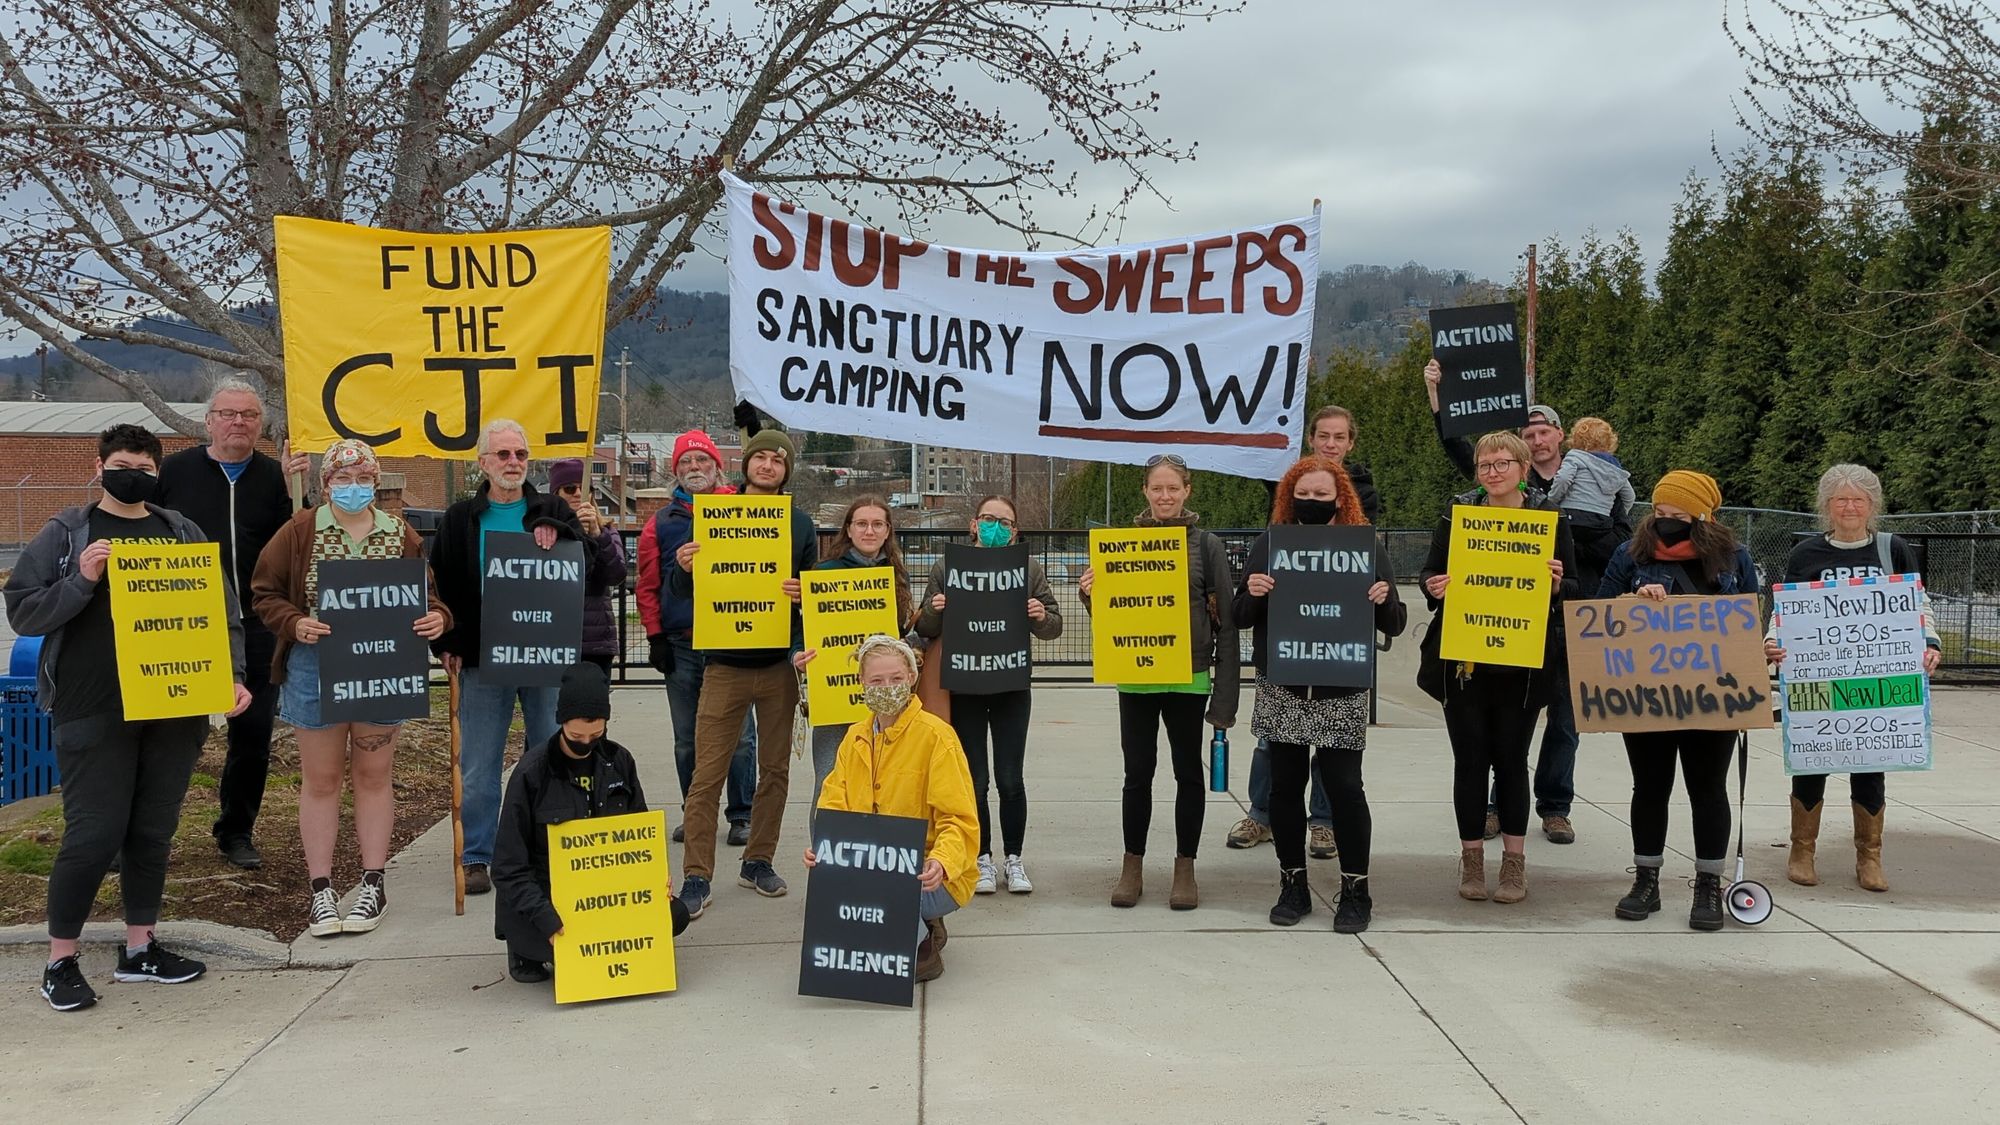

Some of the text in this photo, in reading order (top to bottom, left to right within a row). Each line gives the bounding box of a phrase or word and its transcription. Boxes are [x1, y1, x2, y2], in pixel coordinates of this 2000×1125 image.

[752, 192, 1306, 316] STOP THE SWEEPS
[381, 243, 536, 290] FUND
[422, 305, 506, 352] THE
[756, 288, 1024, 375] SANCTUARY
[1436, 324, 1513, 347] ACTION
[1462, 368, 1496, 380] OVER
[779, 356, 965, 421] CAMPING
[1039, 340, 1302, 426] NOW!
[322, 353, 594, 451] CJI
[1450, 394, 1522, 417] SILENCE
[703, 507, 783, 519] DON'T MAKE
[709, 528, 779, 538] DECISIONS
[1463, 518, 1548, 535] DON'T MAKE
[1099, 540, 1179, 553] DON'T MAKE
[1468, 539, 1541, 555] DECISIONS
[118, 556, 211, 570] DON'T MAKE
[487, 558, 578, 581] ACTION
[711, 562, 776, 574] ABOUT US
[1106, 560, 1176, 573] DECISIONS
[1273, 550, 1369, 573] ACTION
[127, 578, 207, 592] DECISIONS
[811, 578, 889, 594] DON'T MAKE
[947, 568, 1024, 591] ACTION
[1465, 575, 1535, 590] ABOUT US
[321, 585, 419, 610] ACTION
[818, 598, 886, 613] DECISIONS
[1110, 595, 1175, 608] ABOUT US
[1781, 587, 1917, 619] FDR's New Deal
[713, 601, 775, 613] WITHOUT
[1300, 604, 1340, 617] OVER
[134, 616, 208, 632] ABOUT US
[513, 611, 552, 623] OVER
[1464, 613, 1530, 630] WITHOUT
[1575, 598, 1757, 638] 26 SWEEPS
[736, 621, 752, 632] US
[969, 621, 1005, 632] OVER
[353, 640, 395, 654] OVER
[822, 634, 865, 648] ABOUT
[1113, 635, 1176, 647] WITHOUT
[1486, 636, 1504, 647] US
[493, 646, 575, 664] SILENCE
[1279, 641, 1366, 662] SILENCE
[1604, 642, 1722, 677] IN 2021
[1795, 641, 1913, 663] made life BETTER
[140, 660, 211, 676] WITHOUT
[952, 651, 1026, 671] SILENCE
[1136, 656, 1153, 667] US
[1792, 660, 1917, 679] for most Americans
[334, 676, 424, 701] SILENCE
[826, 673, 860, 687] WITH
[1788, 682, 1828, 694] THE
[168, 685, 187, 698] US
[1788, 678, 1919, 711] GREEN New Deal
[1580, 681, 1719, 721] HOUSING
[1792, 734, 1922, 754] makes life POSSIBLE
[1805, 756, 1834, 767] FOR
[1841, 755, 1869, 766] ALL
[1901, 753, 1925, 765] US
[561, 827, 655, 849] DON'T MAKE
[571, 850, 652, 871] DECISIONS
[815, 839, 917, 875] ACTION
[575, 890, 651, 912] ABOUT US
[840, 905, 884, 923] OVER
[580, 937, 653, 957] WITHOUT
[608, 963, 628, 978] US
[815, 947, 909, 977] SILENCE
